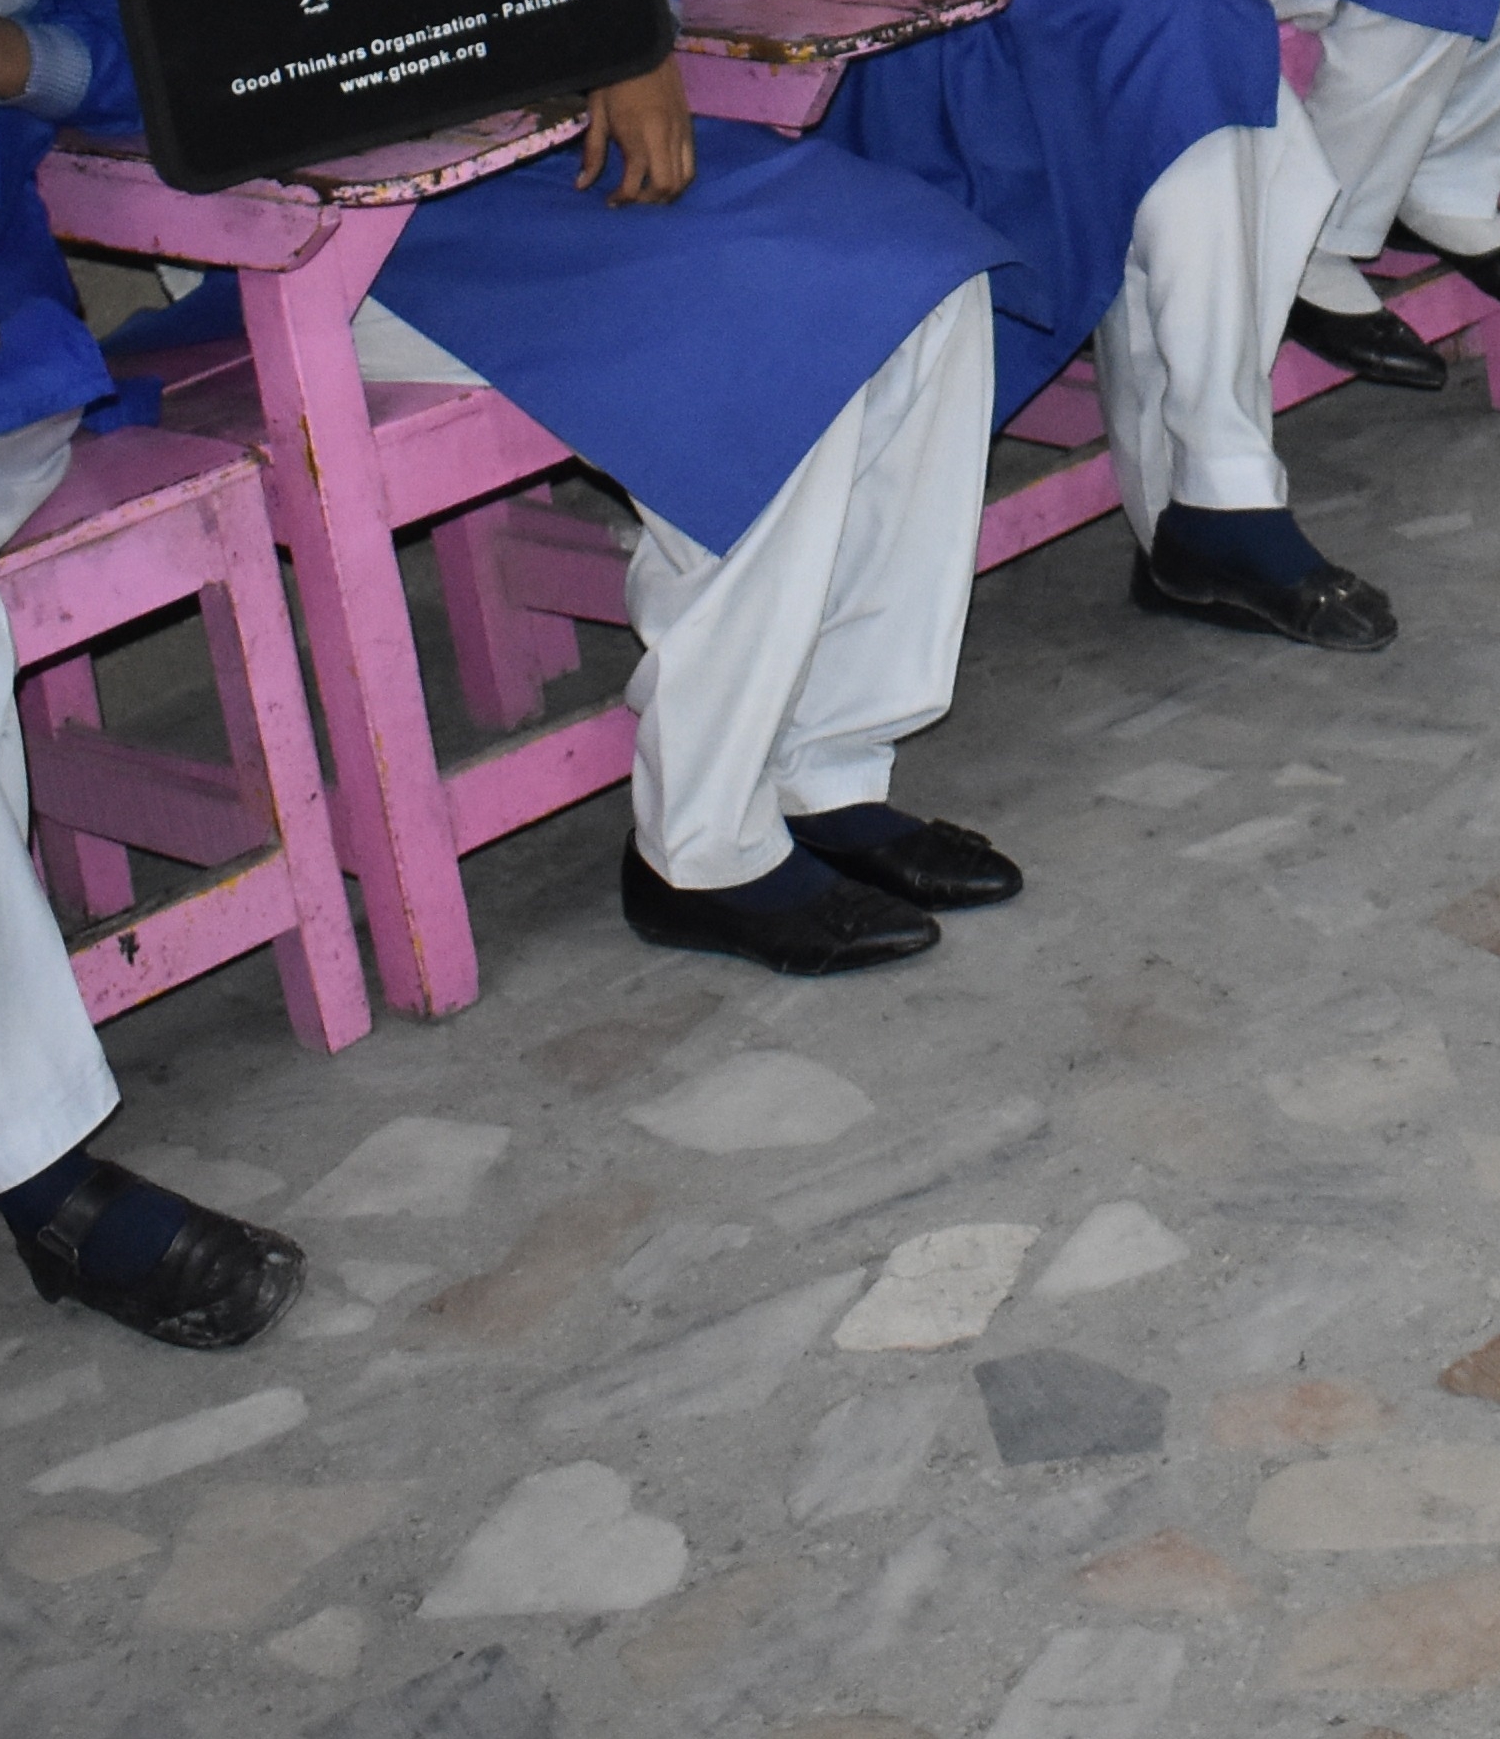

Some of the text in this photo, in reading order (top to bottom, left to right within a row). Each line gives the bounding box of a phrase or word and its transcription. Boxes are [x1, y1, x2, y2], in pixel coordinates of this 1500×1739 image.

[230, 67, 282, 97] Good
[284, 45, 368, 81] Thinkers
[370, 10, 488, 57] Organization
[339, 39, 489, 95] www.gtopak.org
